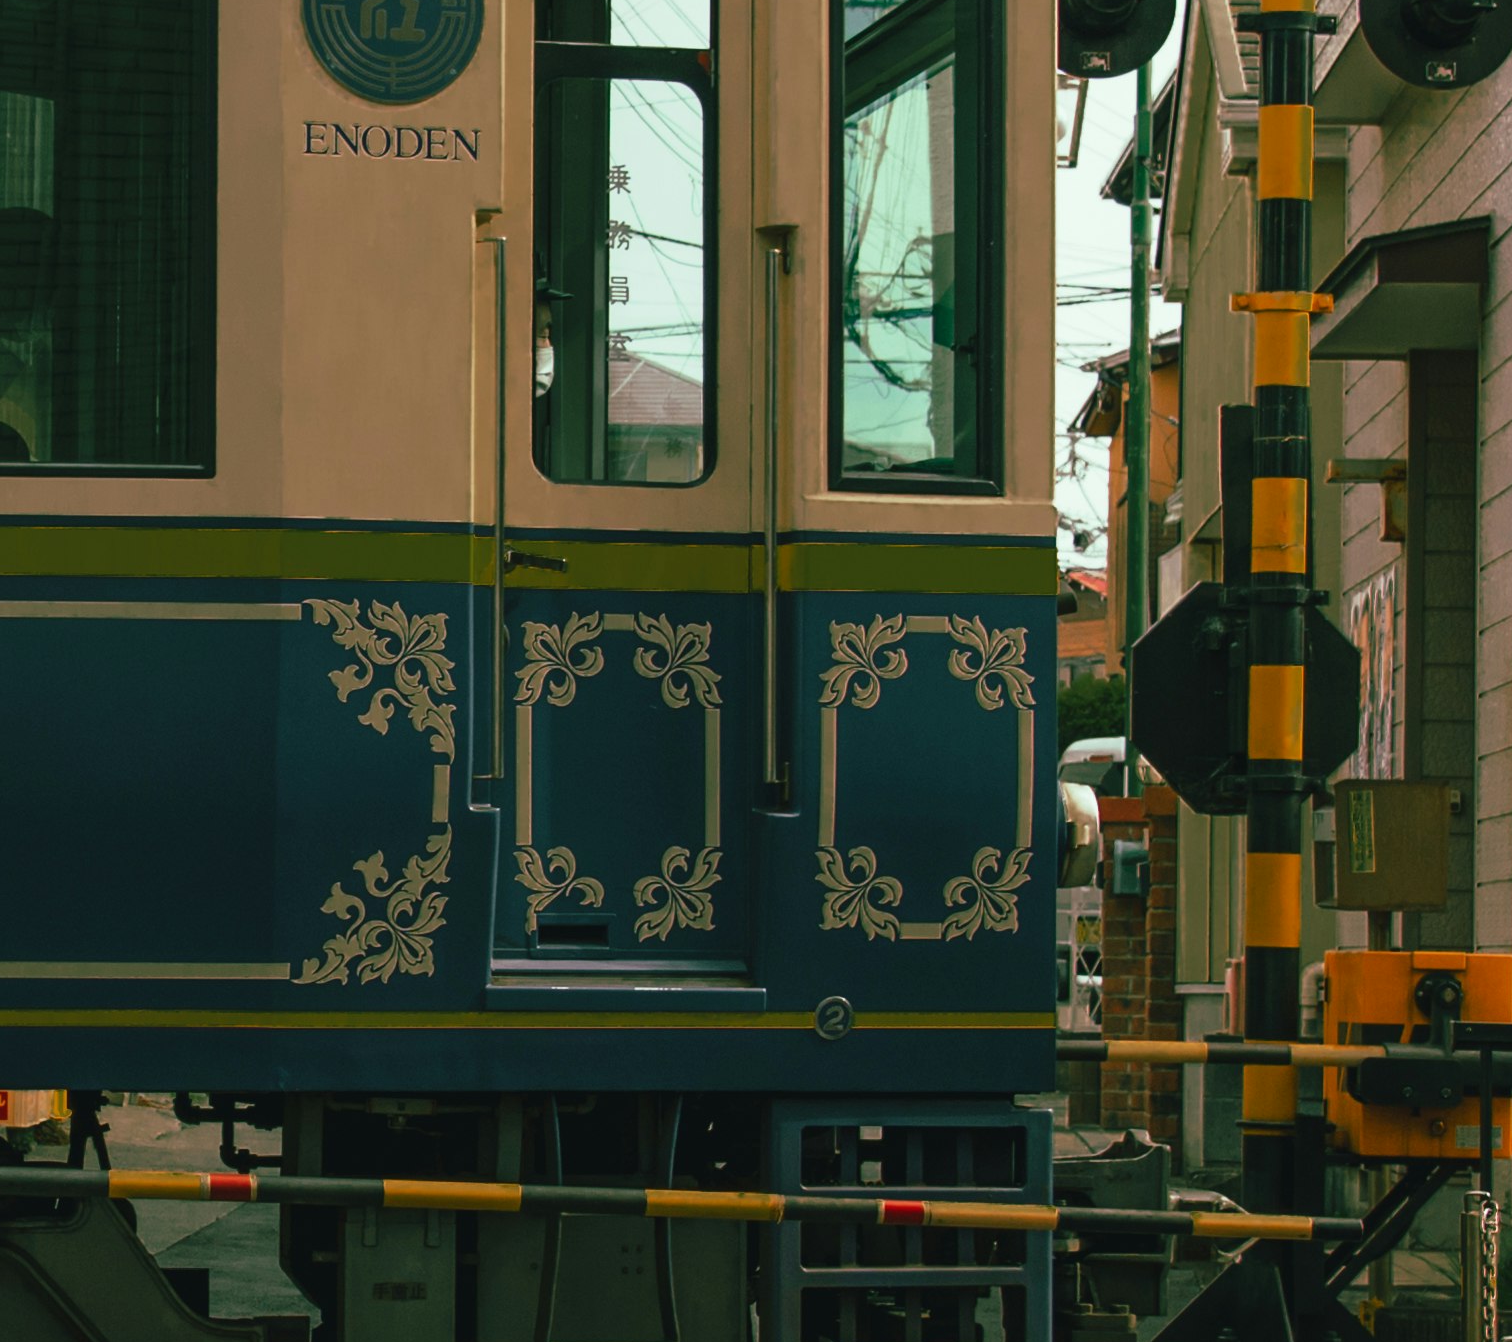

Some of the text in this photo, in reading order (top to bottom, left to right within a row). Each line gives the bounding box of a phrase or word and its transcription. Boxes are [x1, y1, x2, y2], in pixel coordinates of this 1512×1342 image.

[302, 120, 482, 162] ENODEN
[606, 163, 633, 363] 乗務員室
[823, 1005, 845, 1031] 2
